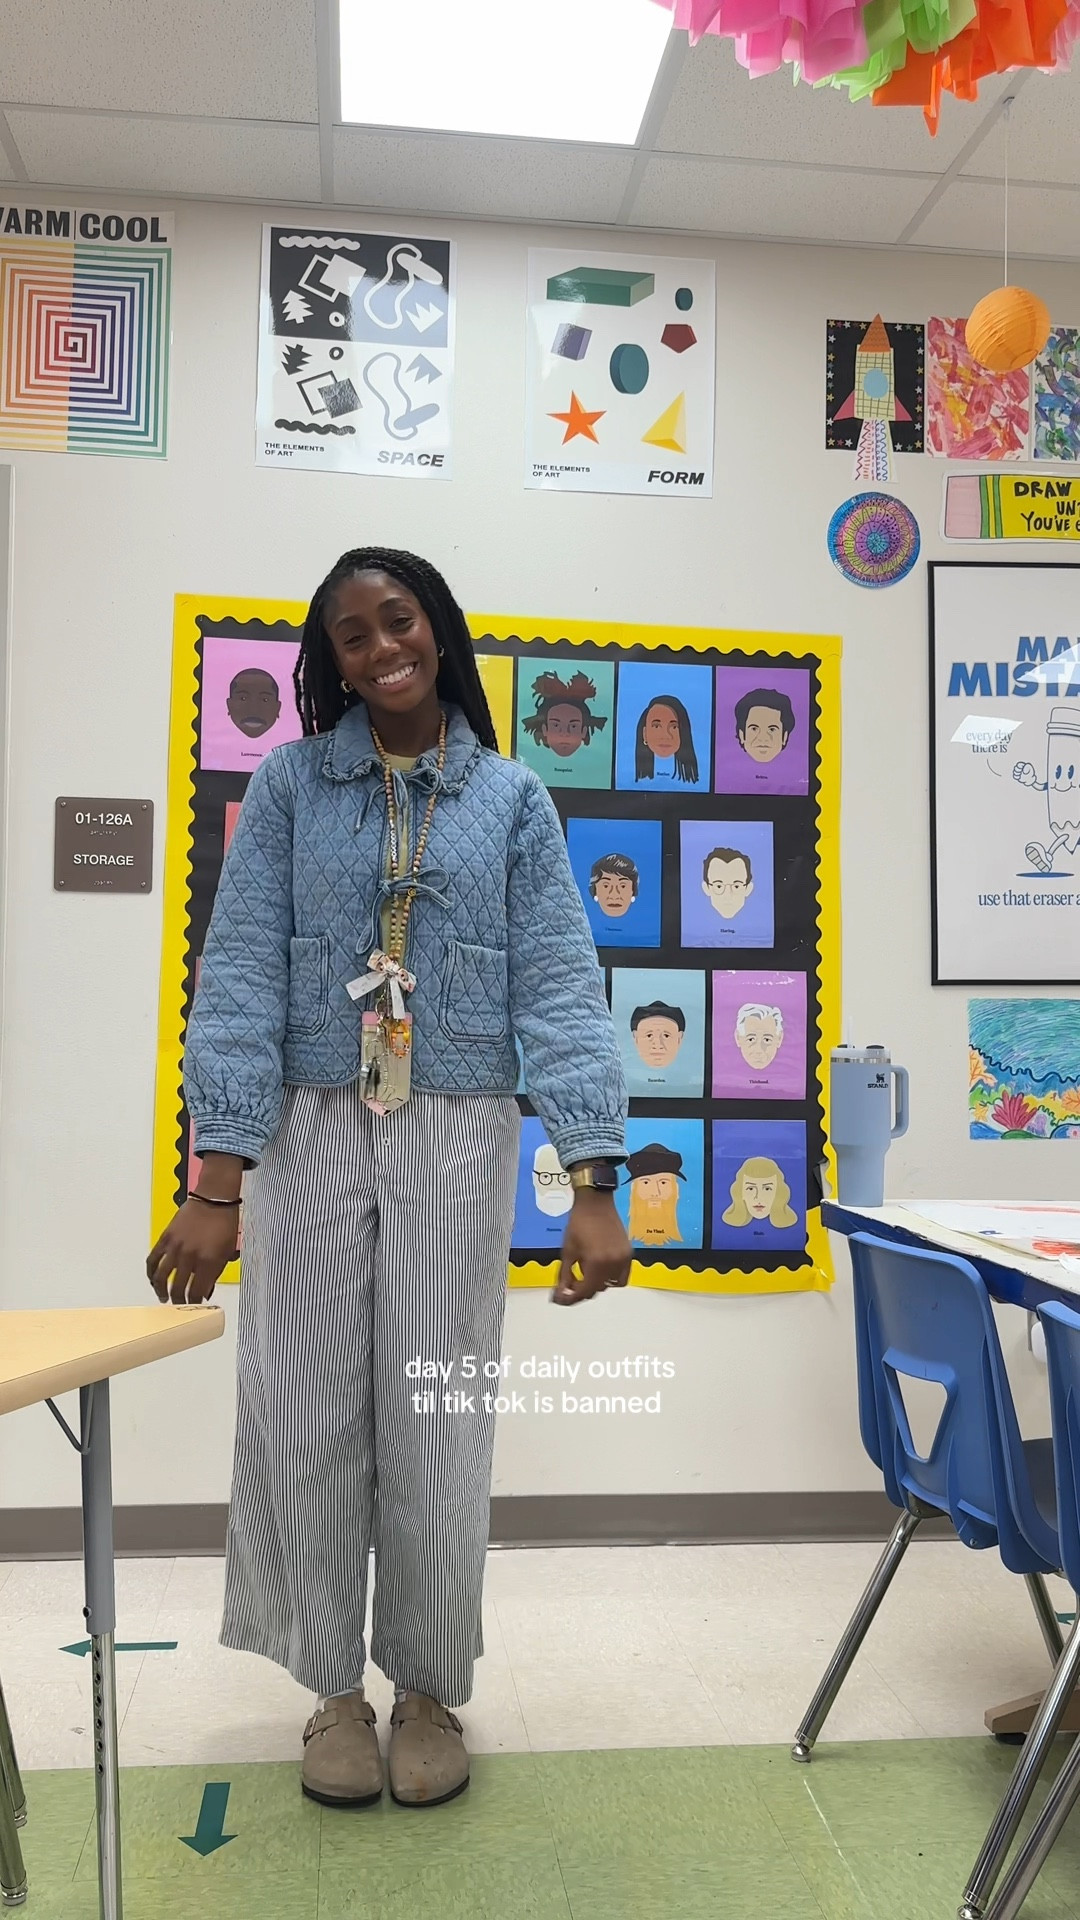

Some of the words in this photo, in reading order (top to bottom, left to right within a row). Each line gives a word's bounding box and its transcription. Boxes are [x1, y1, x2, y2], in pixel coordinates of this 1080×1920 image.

[79, 213, 168, 243] COOL
[282, 443, 325, 452] ELEMENTS
[377, 450, 444, 467] SPACE
[549, 465, 591, 473] ELEMENTS
[647, 470, 705, 485] FORM
[1014, 481, 1072, 499] DRAW
[1016, 636, 1080, 662] MA
[966, 731, 993, 744] every
[995, 729, 1013, 744] day
[971, 741, 998, 753] there
[999, 741, 1008, 753] is
[75, 812, 133, 826] 01-126A
[73, 853, 134, 866] STORAGE
[978, 894, 1000, 906] use
[1002, 889, 1030, 906] that
[1033, 893, 1074, 906] eraser
